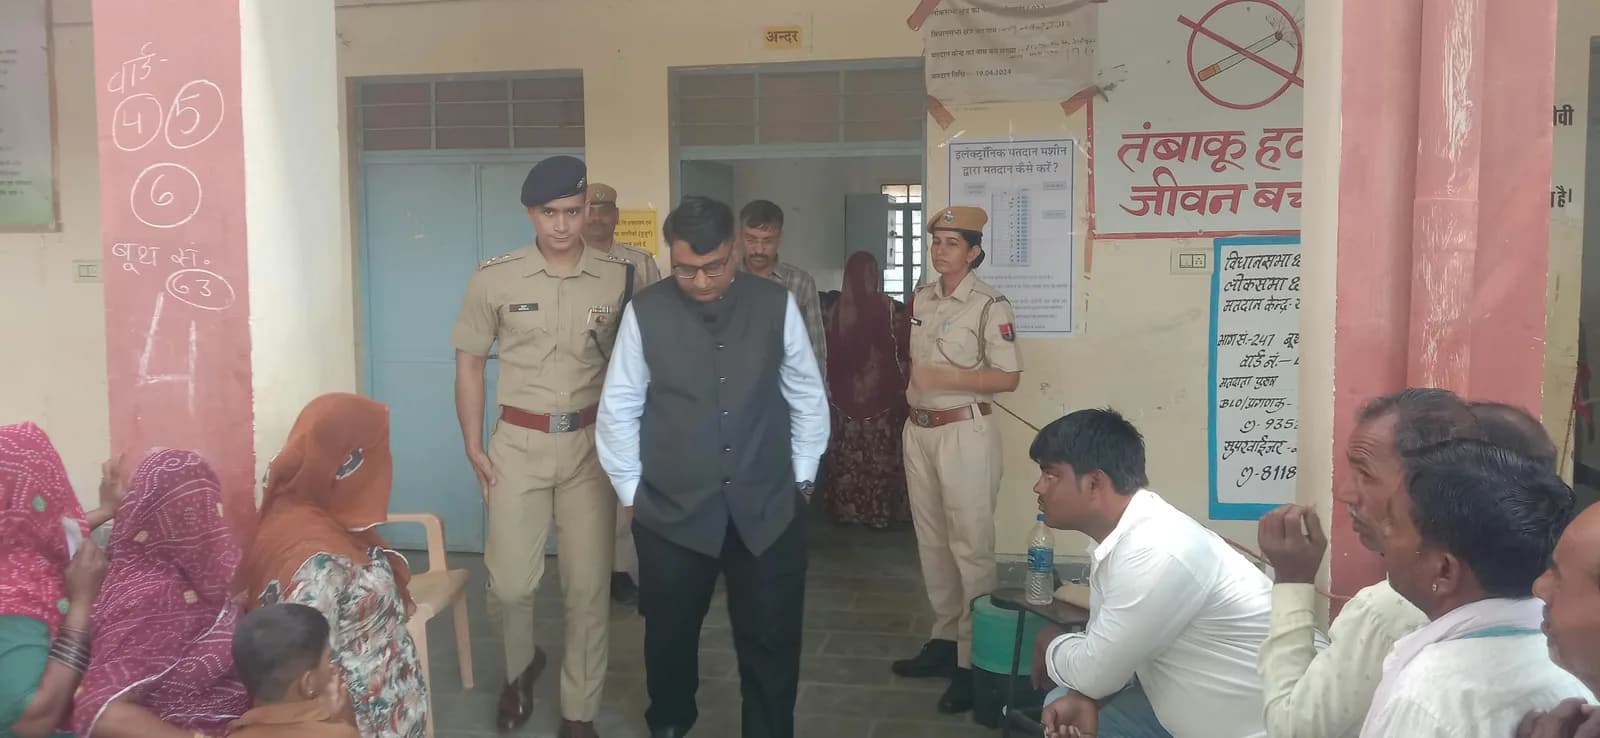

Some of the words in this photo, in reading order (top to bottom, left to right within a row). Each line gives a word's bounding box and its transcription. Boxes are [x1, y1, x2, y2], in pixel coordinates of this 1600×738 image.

[766, 30, 799, 43] अन्दर
[1553, 104, 1574, 126] वी
[1008, 147, 1038, 158] मतदान
[1040, 143, 1067, 157] मशीन
[1117, 121, 1247, 172] तंबाकू
[962, 166, 981, 177] द्वारा
[983, 165, 1013, 175] मतदान
[1015, 161, 1033, 173] कैसे
[1119, 166, 1248, 216] जीवन
[1224, 250, 1293, 271] विधानसभा
[1224, 273, 1288, 292] लोकसभा
[1223, 298, 1265, 312] मतदान
[1239, 349, 1265, 368] वार्ड
[1219, 375, 1253, 388] मतदाता
